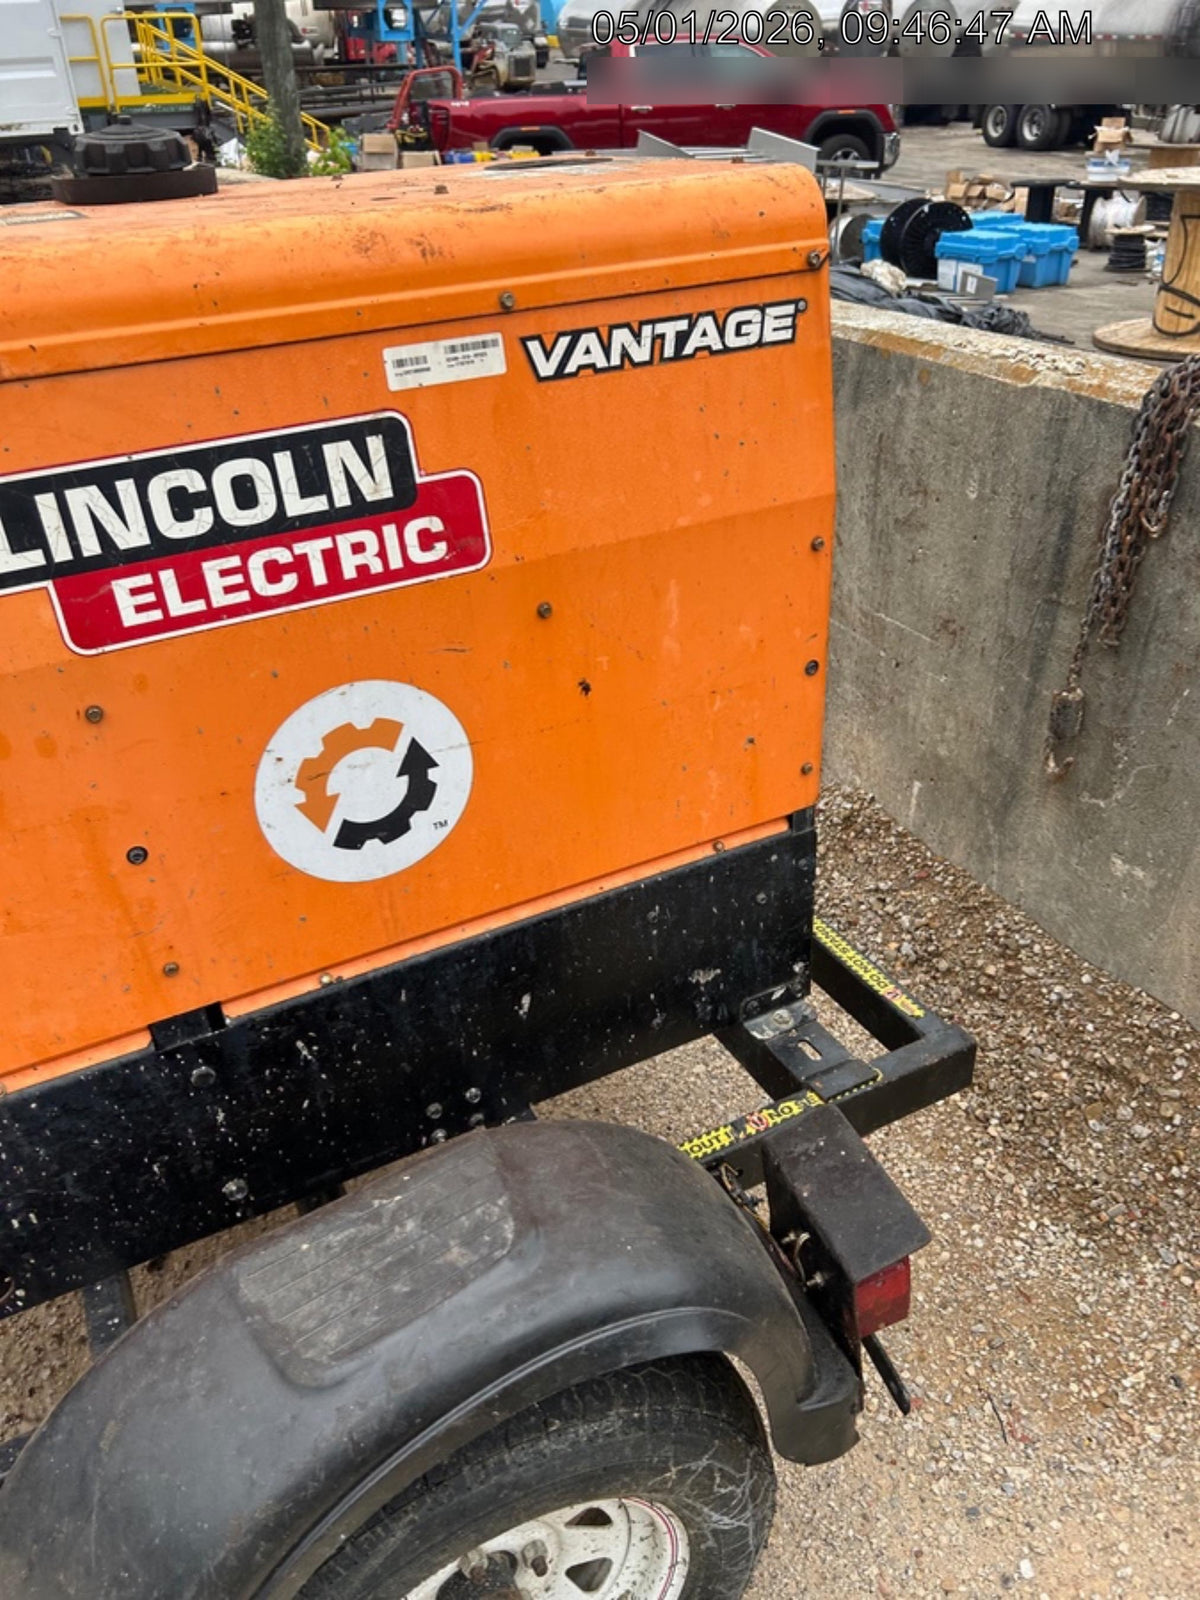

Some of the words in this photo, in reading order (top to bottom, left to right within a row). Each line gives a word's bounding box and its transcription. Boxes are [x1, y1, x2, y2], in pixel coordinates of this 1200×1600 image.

[525, 302, 797, 378] VANTAGE
[111, 515, 449, 628] ELECTRIC
[869, 972, 889, 990] DO
[768, 1104, 794, 1121] NO
